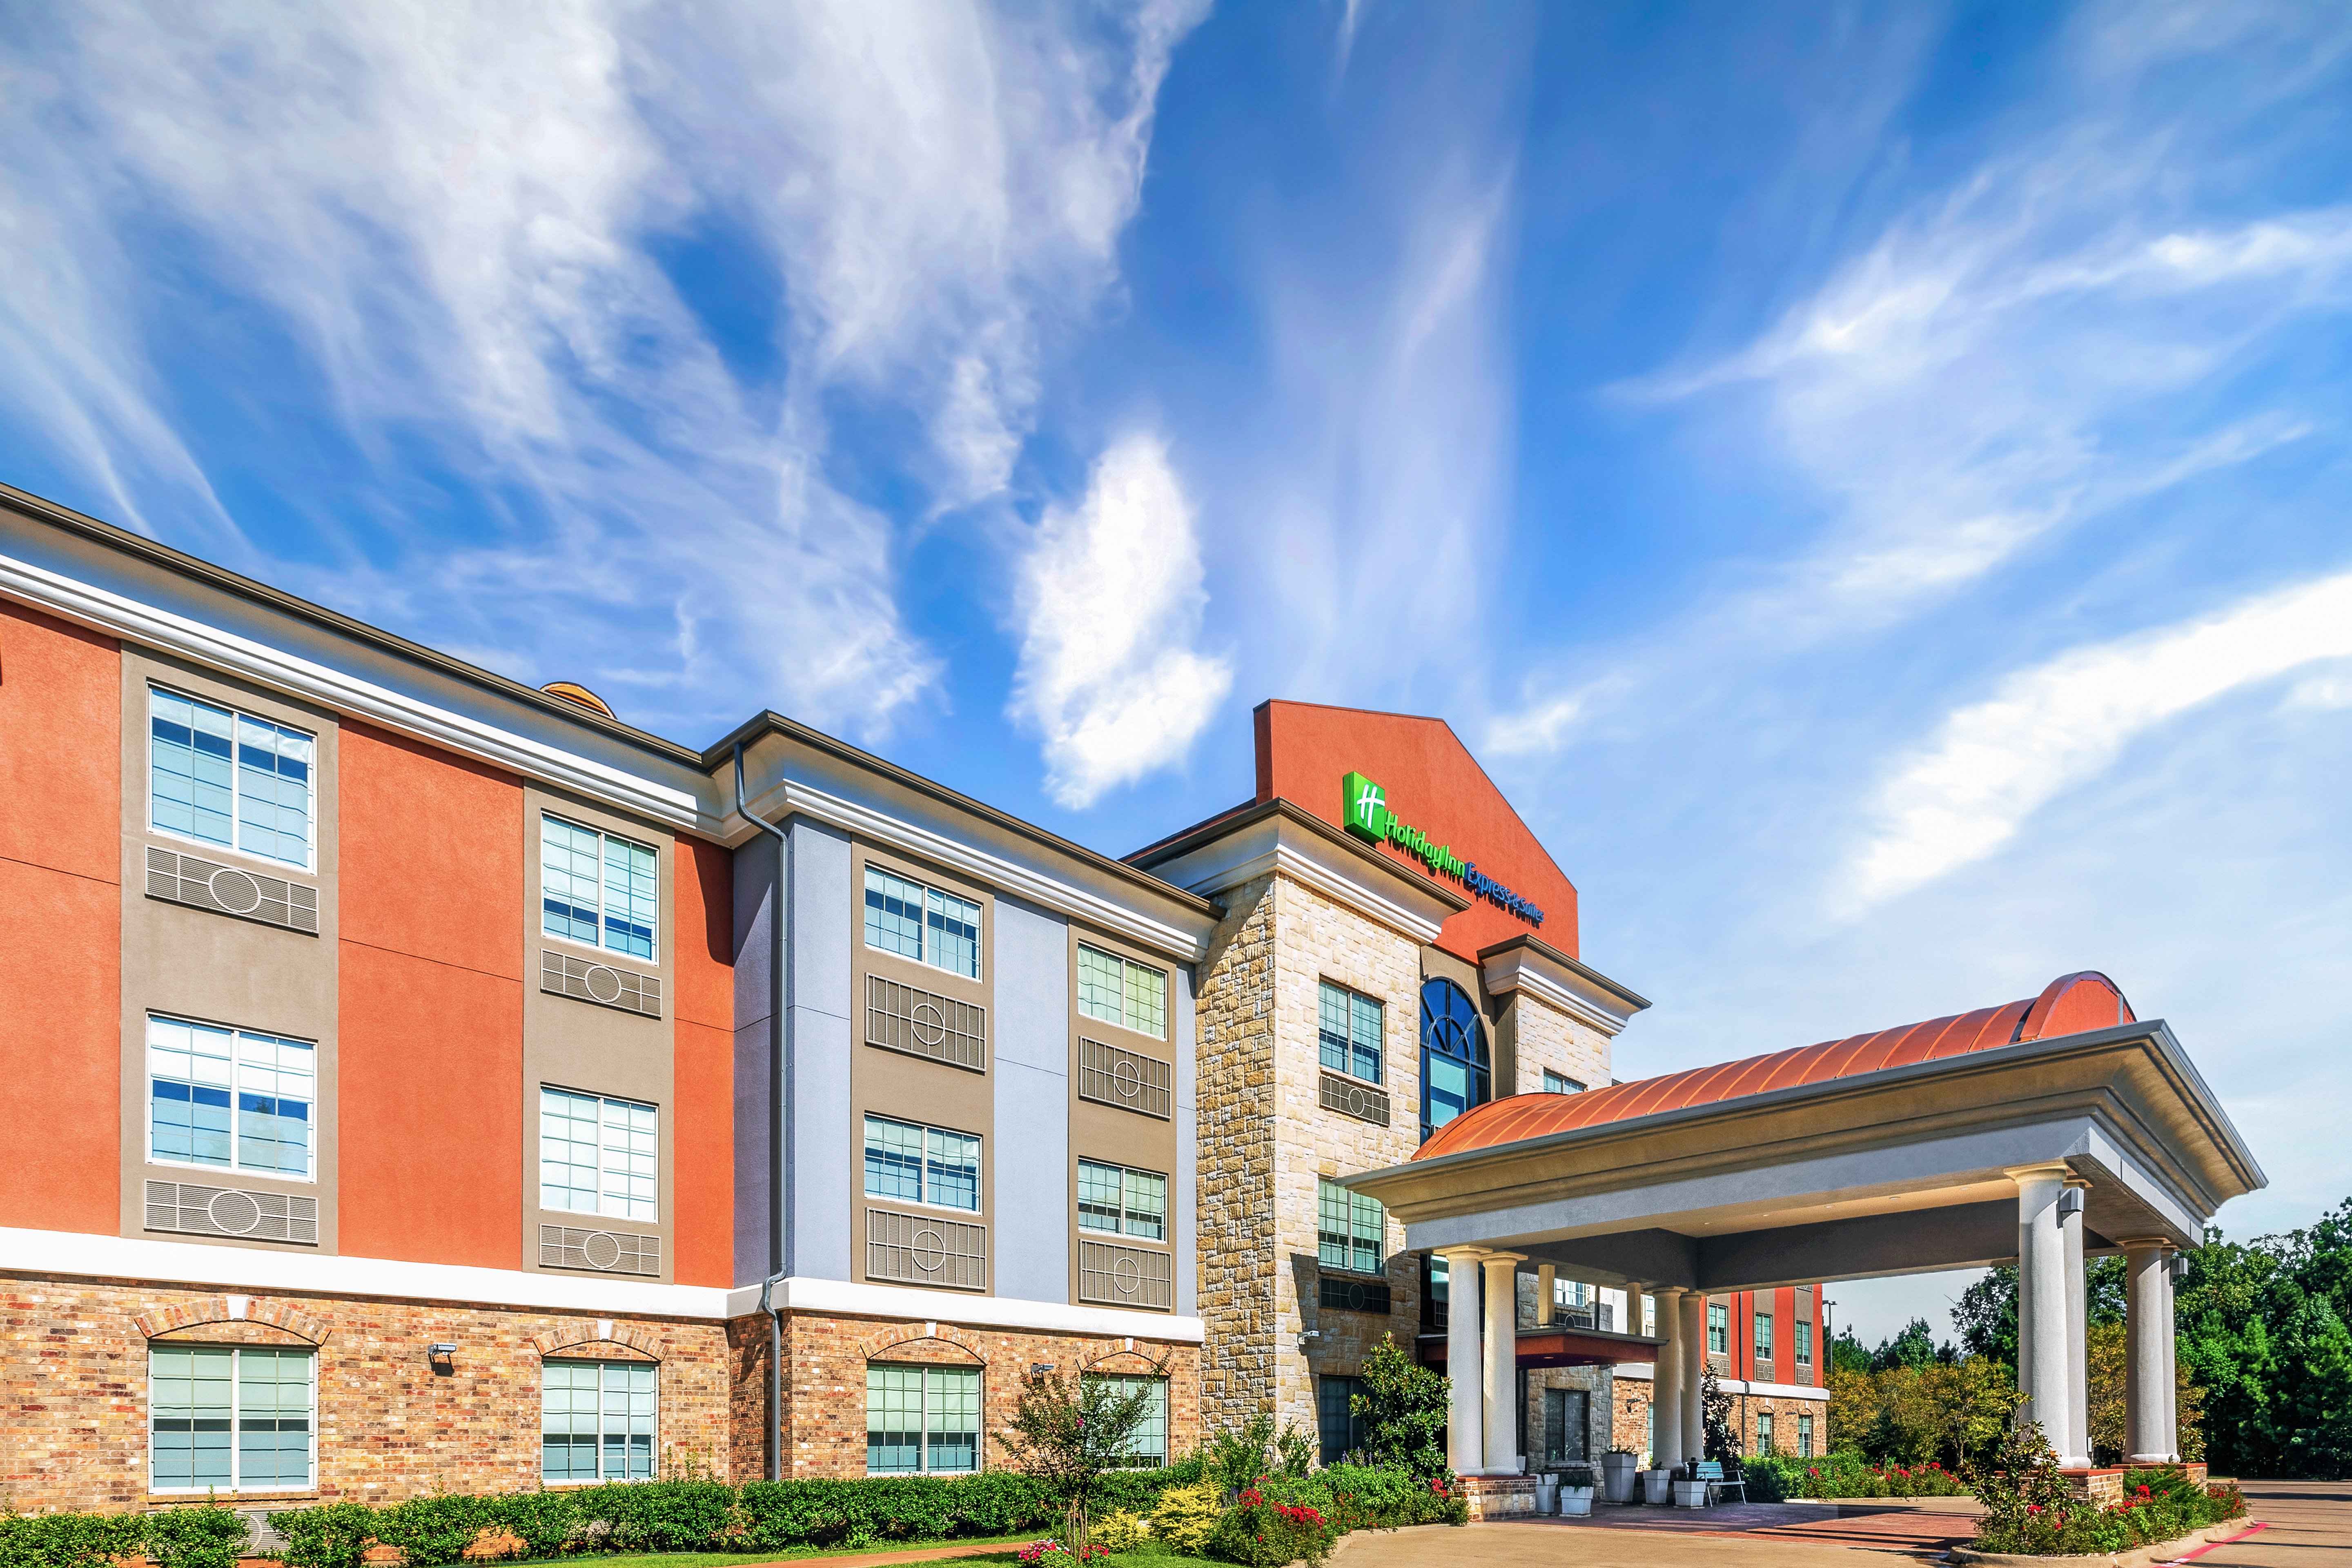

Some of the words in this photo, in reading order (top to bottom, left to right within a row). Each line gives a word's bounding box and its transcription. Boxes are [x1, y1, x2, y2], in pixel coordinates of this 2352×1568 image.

[1385, 810, 1442, 869] Holiday
[1443, 845, 1465, 878] Inn
[1468, 862, 1510, 904] Express
[1512, 893, 1519, 908] &
[1520, 898, 1544, 922] Suites
